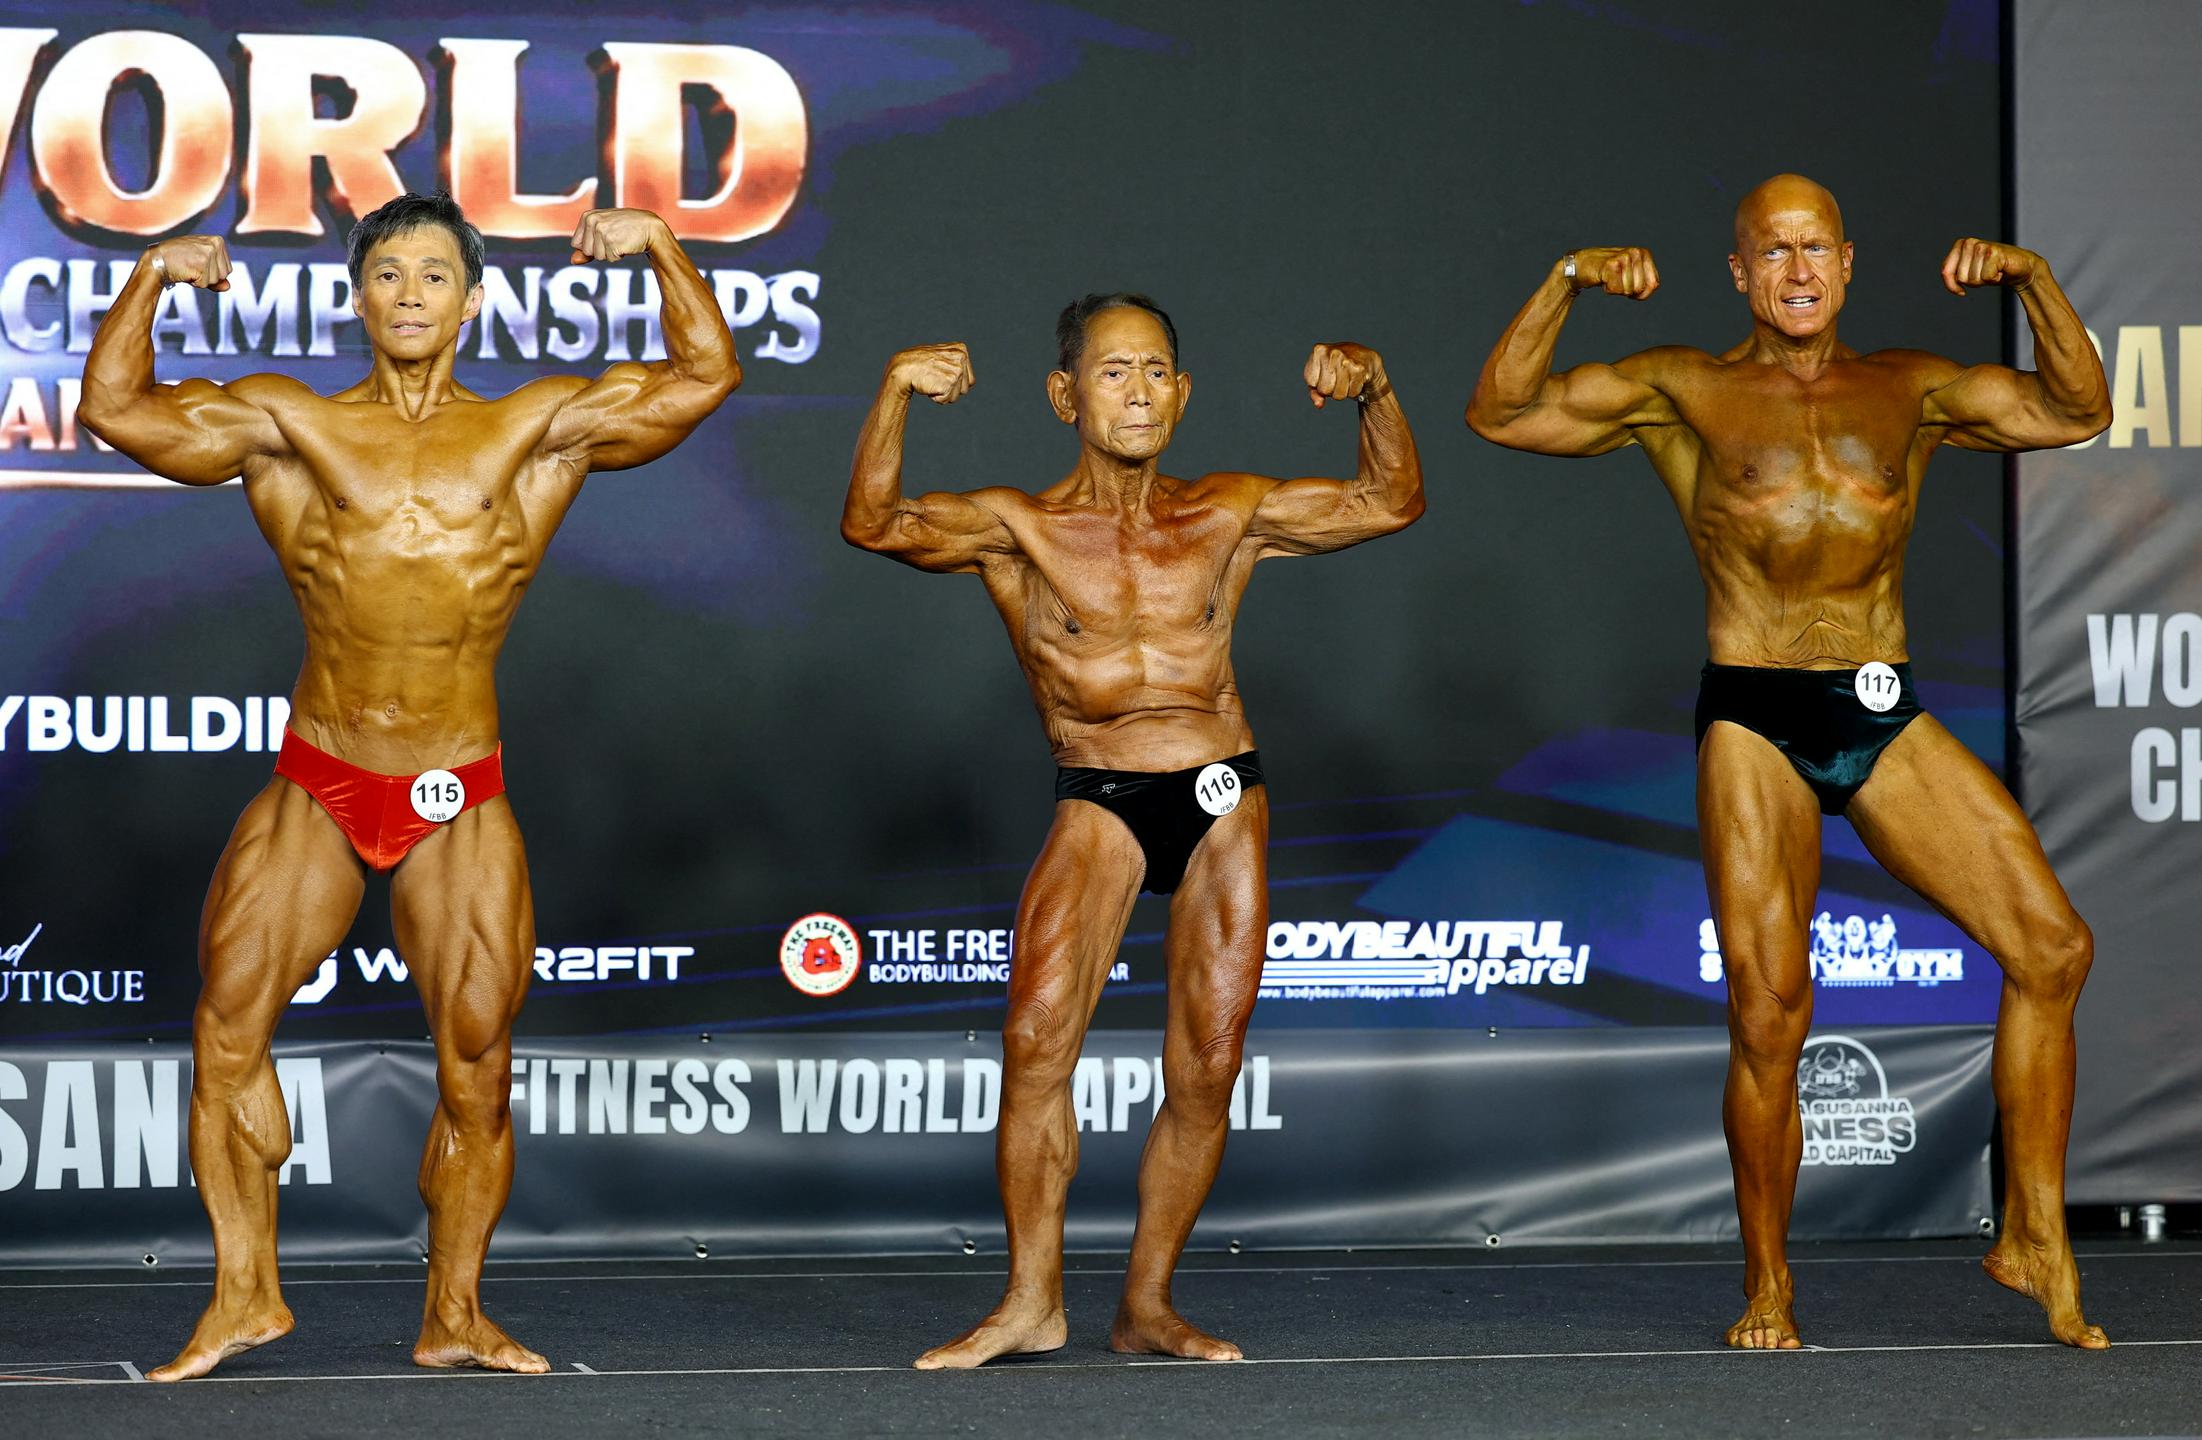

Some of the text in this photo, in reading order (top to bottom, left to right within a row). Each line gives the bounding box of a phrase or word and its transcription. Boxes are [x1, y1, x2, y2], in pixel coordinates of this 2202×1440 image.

[0, 256, 820, 364] CHAMPNSHPS
[1861, 672, 1896, 694] 117
[416, 782, 459, 803] 115
[1200, 770, 1235, 802] 116
[429, 812, 447, 820] IFBB
[1220, 801, 1235, 814] IFBB
[867, 929, 937, 962] THE
[1265, 920, 1573, 960] ODYBEAUTIFUL
[868, 963, 1010, 983] BODYBUILDING
[1430, 944, 1591, 995] apparel
[777, 1057, 1001, 1134] WORLD
[1813, 1101, 1910, 1115] SUSANNA
[1804, 1116, 1912, 1149] NESS
[1826, 1145, 1892, 1160] CAPITAL
